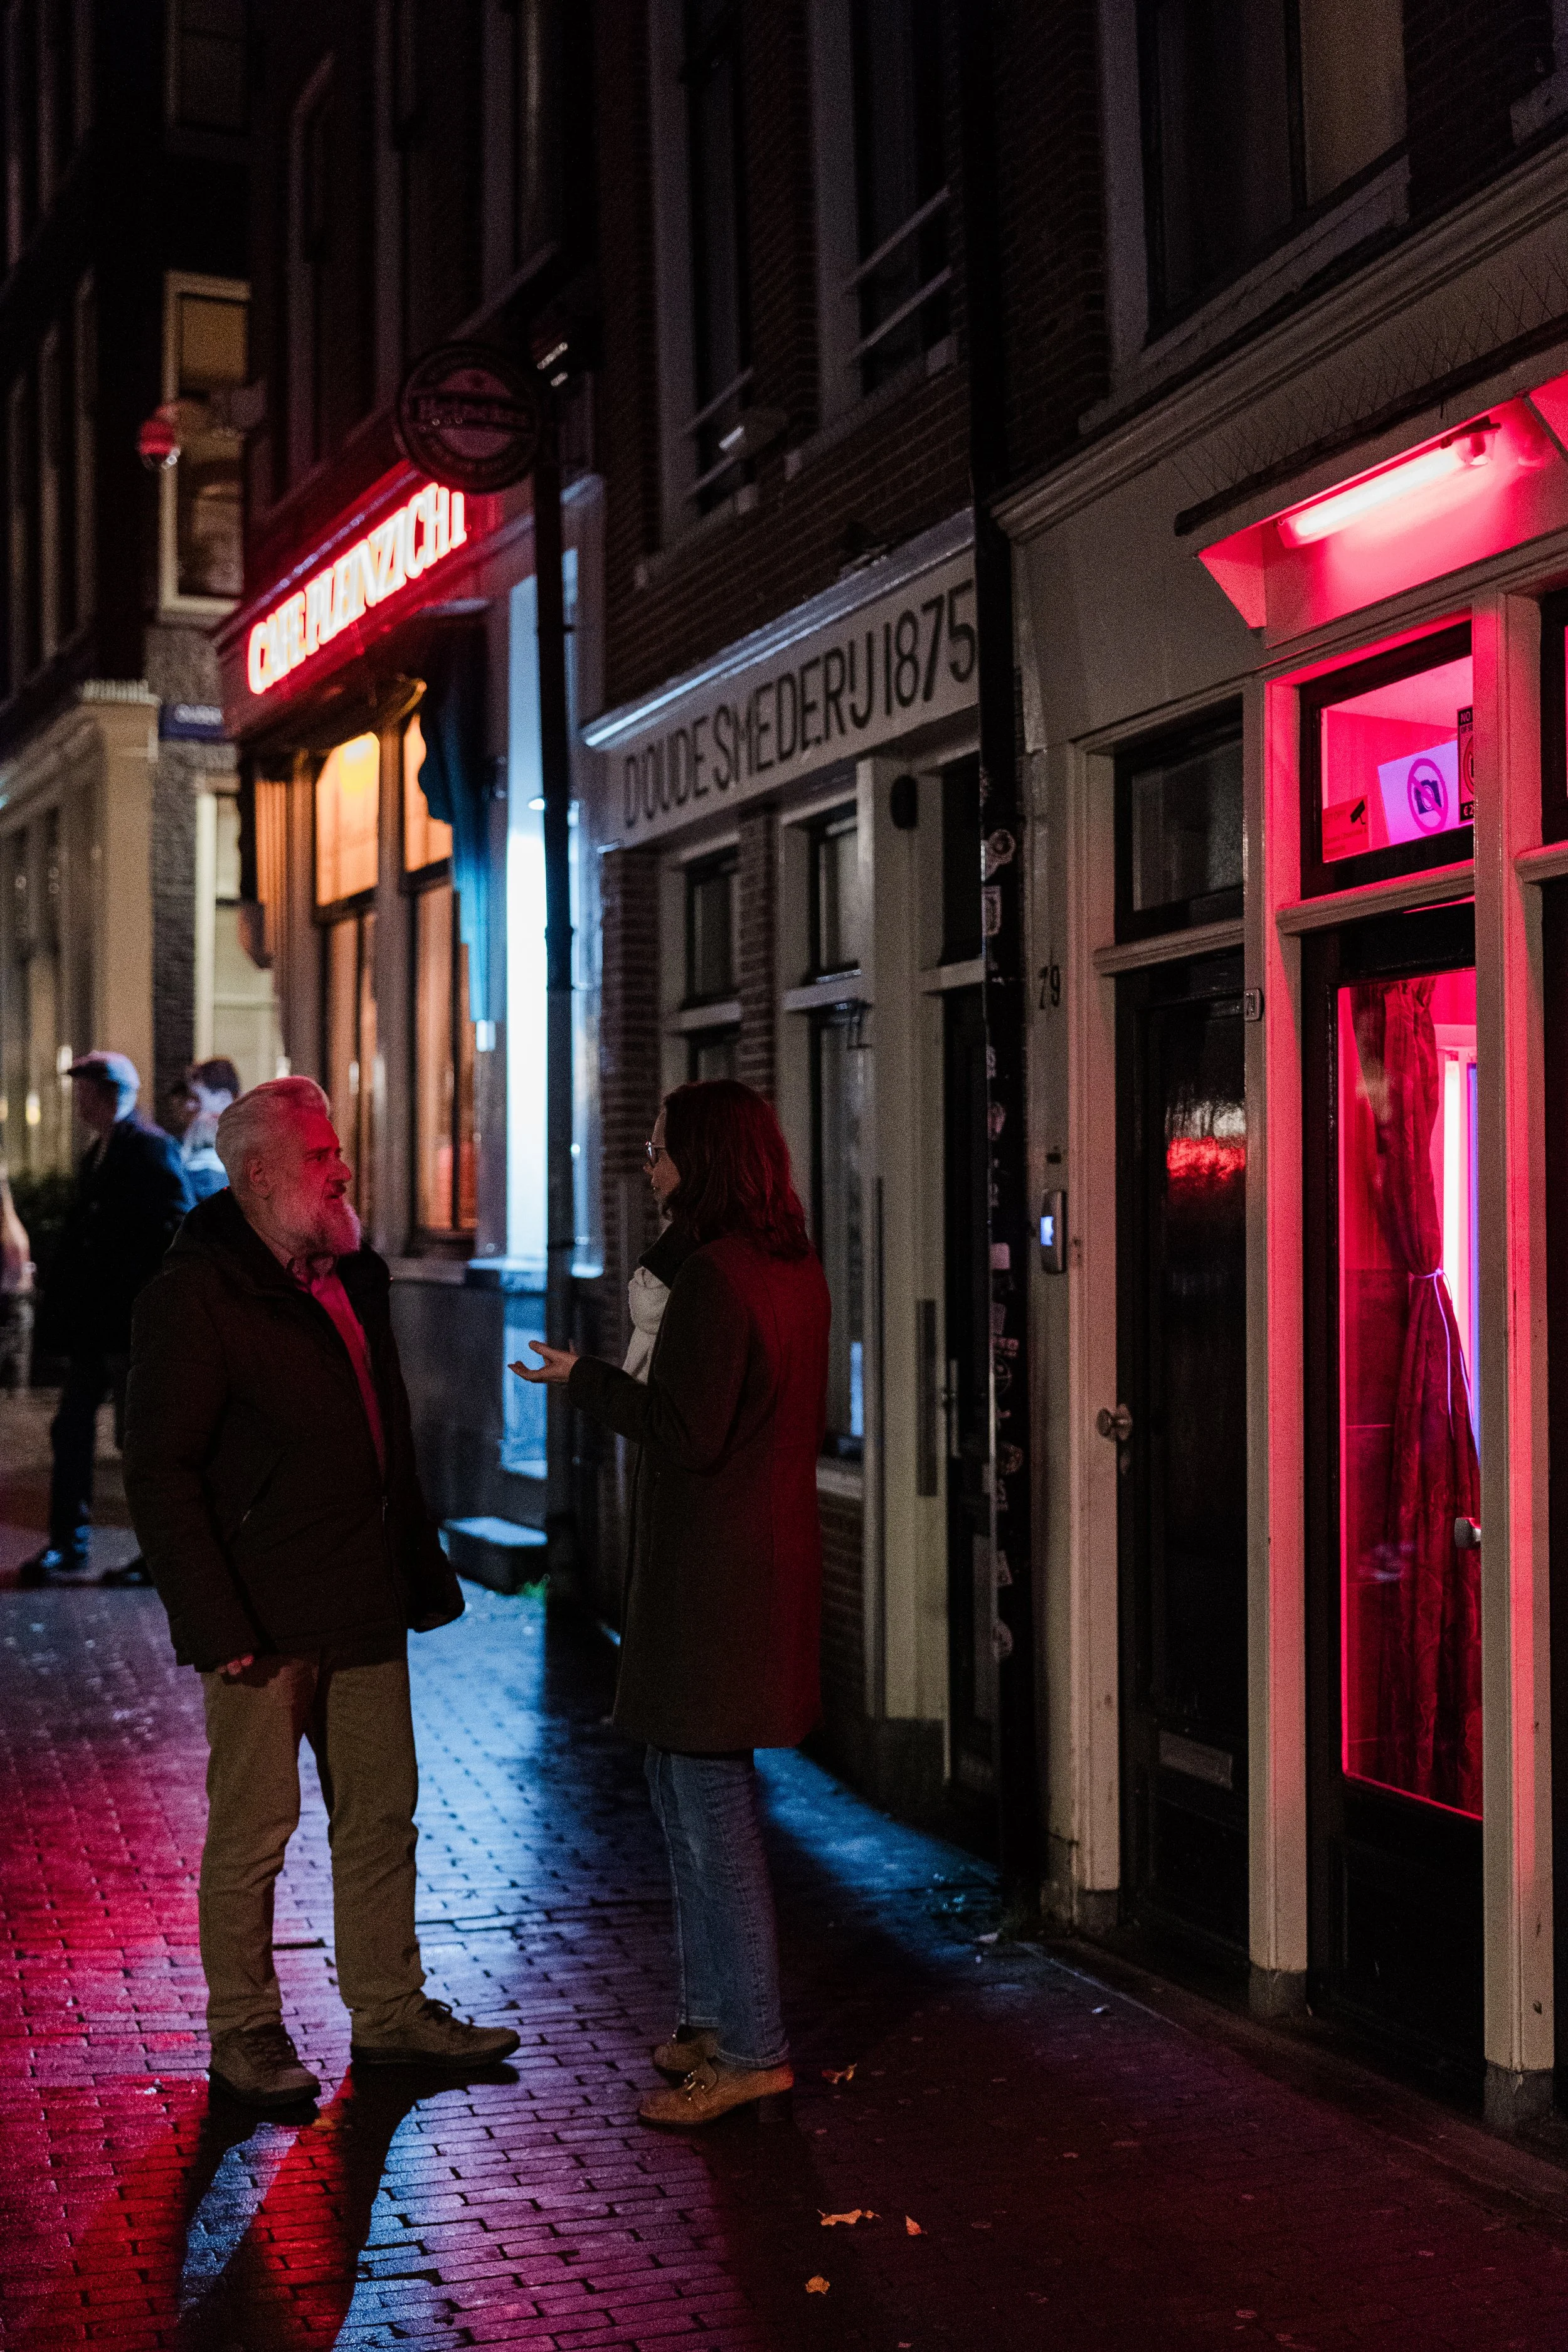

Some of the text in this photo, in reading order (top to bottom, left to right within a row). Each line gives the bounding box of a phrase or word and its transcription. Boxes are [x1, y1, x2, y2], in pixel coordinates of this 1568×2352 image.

[713, 632, 874, 792] SMEDERIJ
[884, 579, 977, 716] 1875
[1460, 711, 1471, 724] NO
